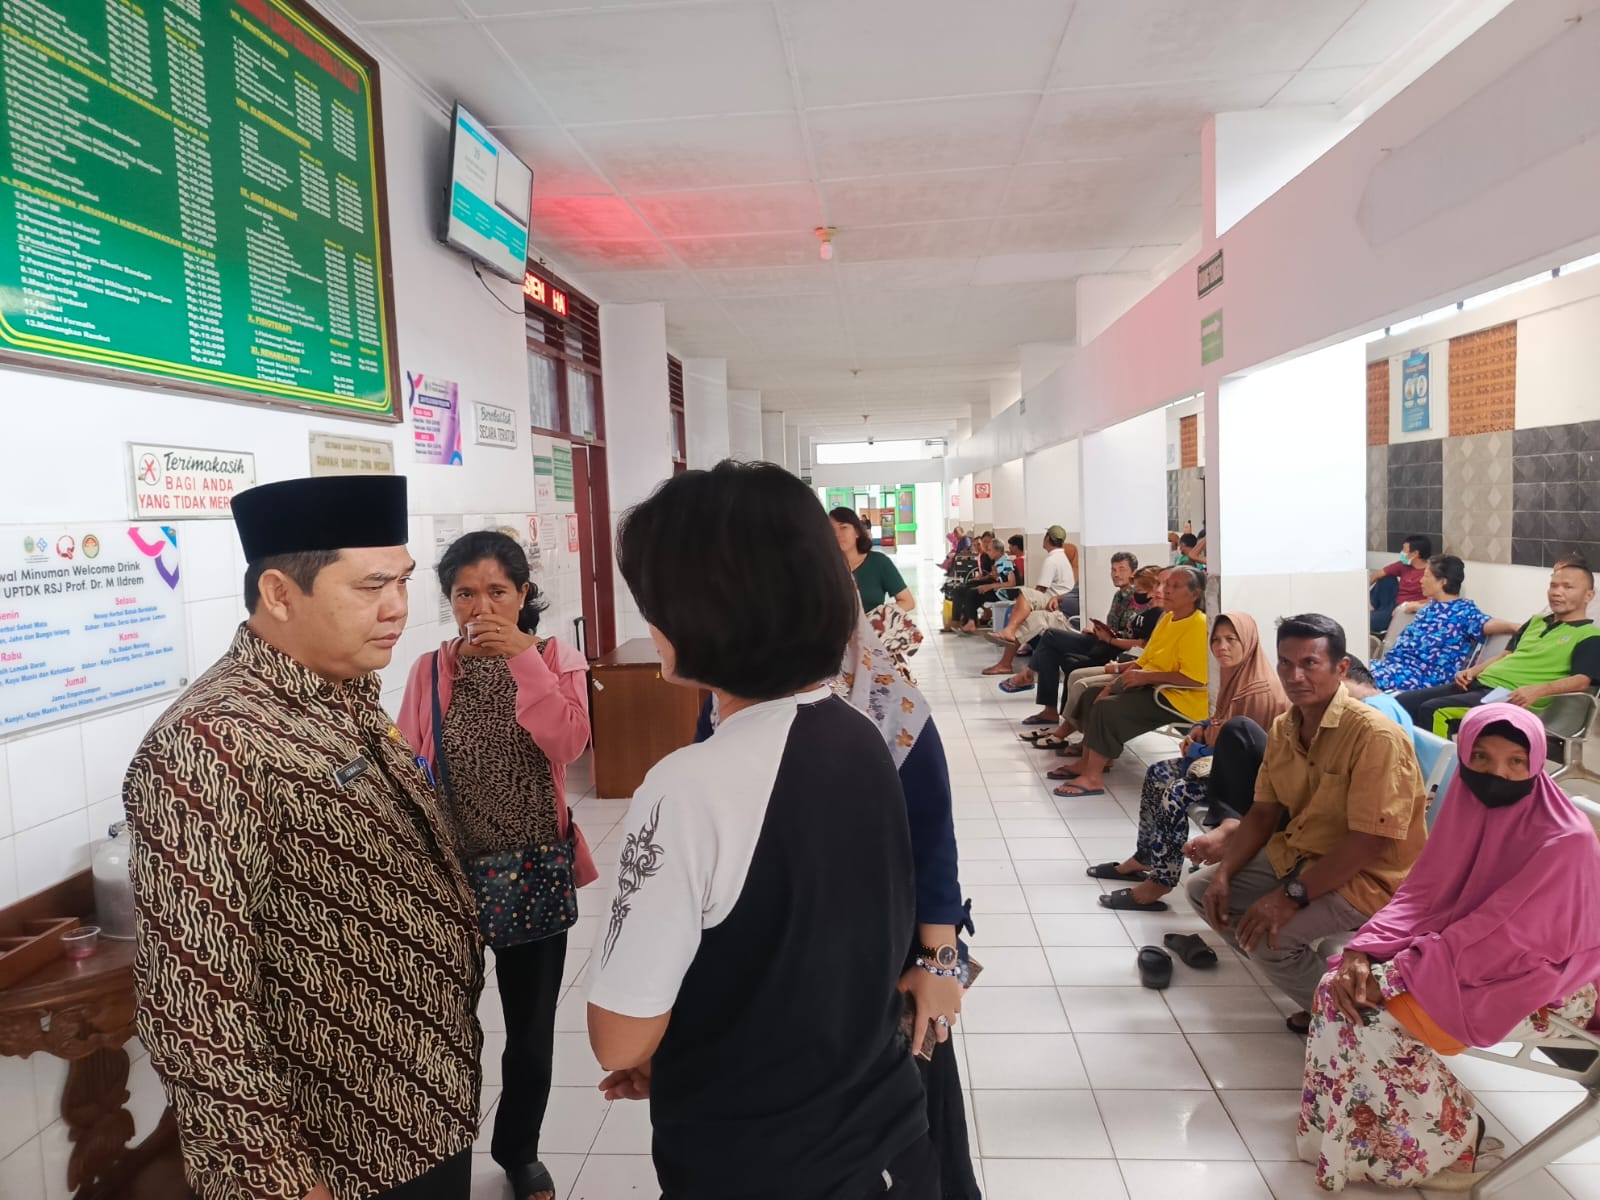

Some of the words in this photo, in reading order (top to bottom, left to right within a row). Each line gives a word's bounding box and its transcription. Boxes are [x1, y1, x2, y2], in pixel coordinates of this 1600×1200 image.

[164, 452, 244, 474] Terimakasih
[166, 476, 196, 491] BAGI
[202, 478, 234, 492] ANDA
[138, 494, 170, 508] YANG
[174, 495, 206, 509] TIDAK
[210, 496, 230, 509] MER
[21, 568, 70, 580] Minuman
[72, 564, 115, 576] Welcome
[118, 562, 140, 572] Drink
[4, 585, 40, 598] UPTDK
[44, 583, 62, 594] RSJ
[66, 581, 88, 592] Prof.
[91, 580, 104, 590] Dr.
[106, 578, 114, 588] M
[117, 575, 144, 586] Ildrem
[0, 652, 22, 662] Rabu
[64, 675, 86, 687] Jumat
